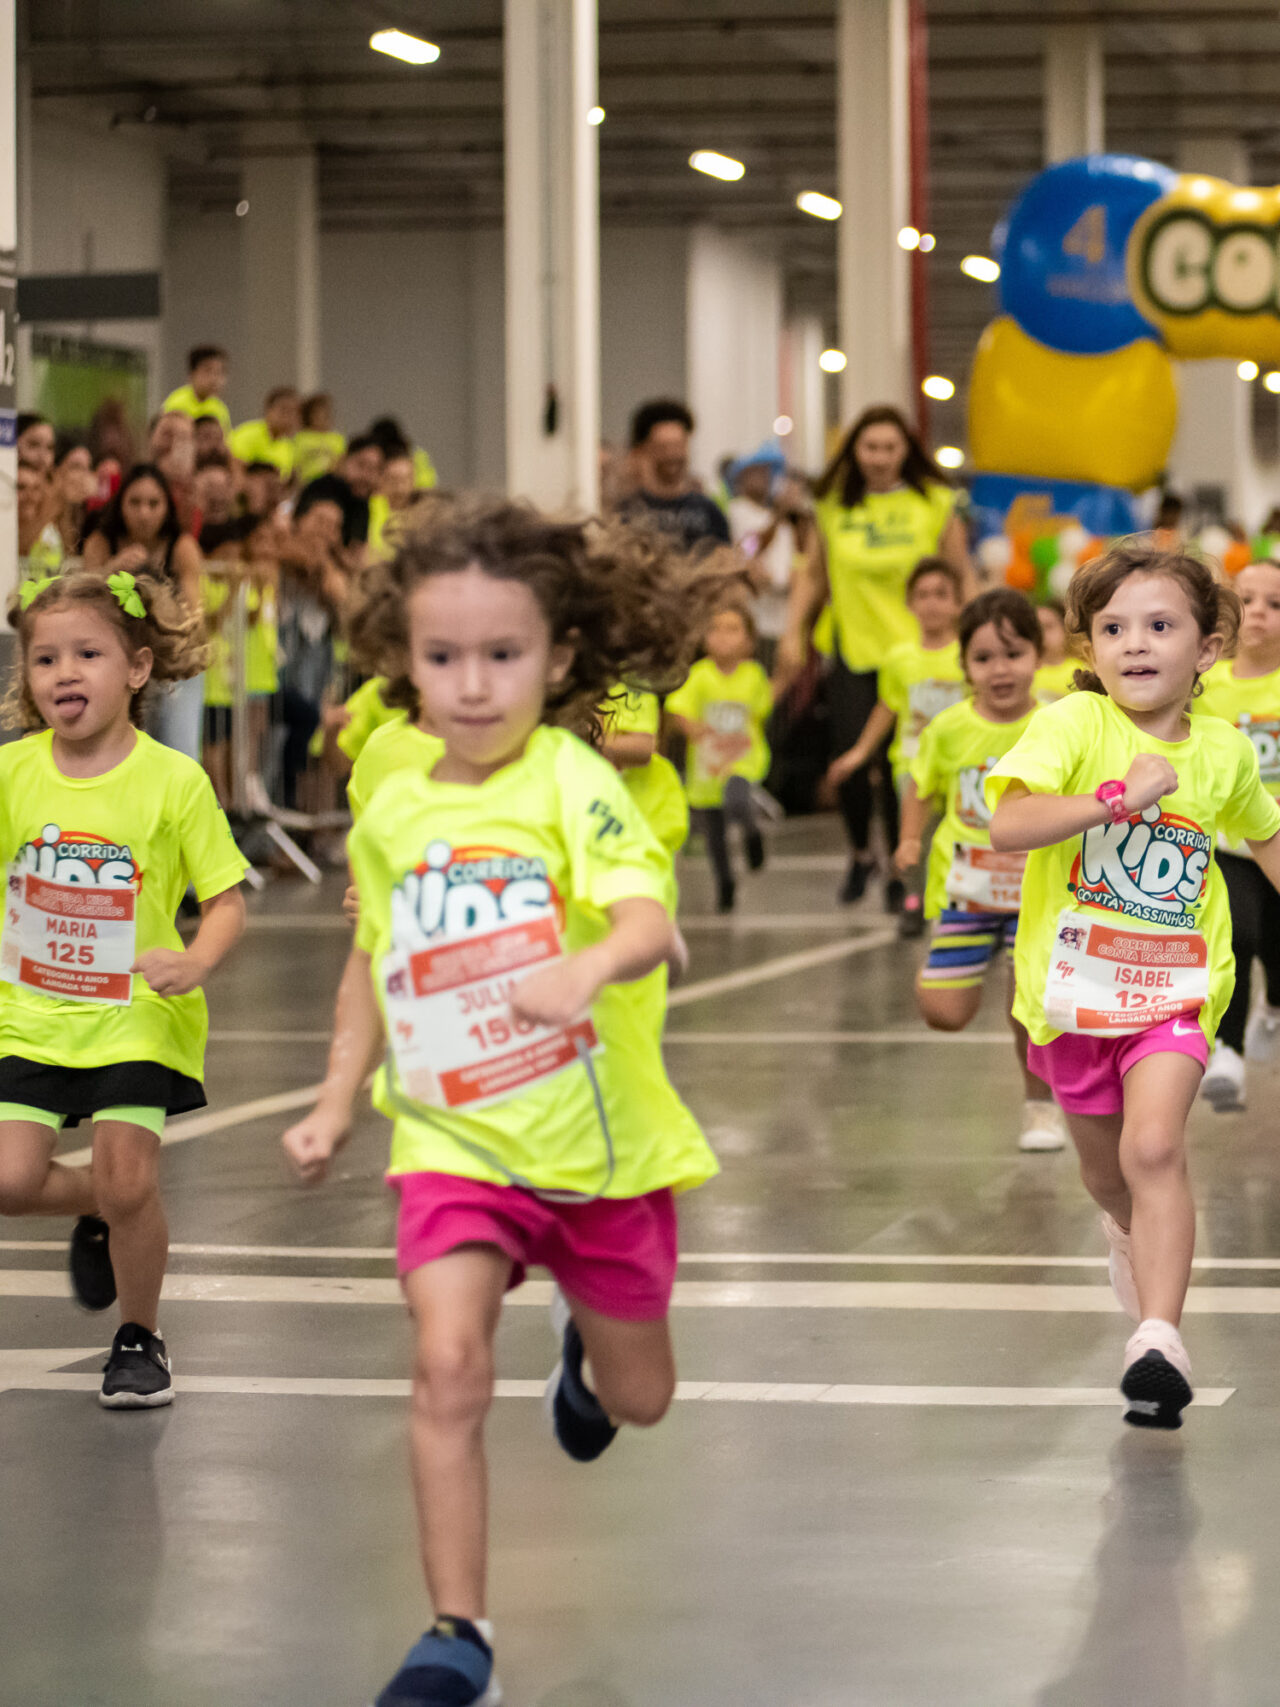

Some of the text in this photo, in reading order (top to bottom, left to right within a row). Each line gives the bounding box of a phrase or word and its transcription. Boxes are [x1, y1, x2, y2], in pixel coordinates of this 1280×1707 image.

[1062, 204, 1107, 264] 4
[1076, 887, 1120, 911] CONTA
[46, 916, 98, 939] MARIA
[47, 940, 95, 966] 125
[1098, 944, 1198, 964] CONTA PASSINHOS
[1113, 937, 1190, 953] CORRIDA KIDS
[1115, 966, 1174, 988] ISABEL
